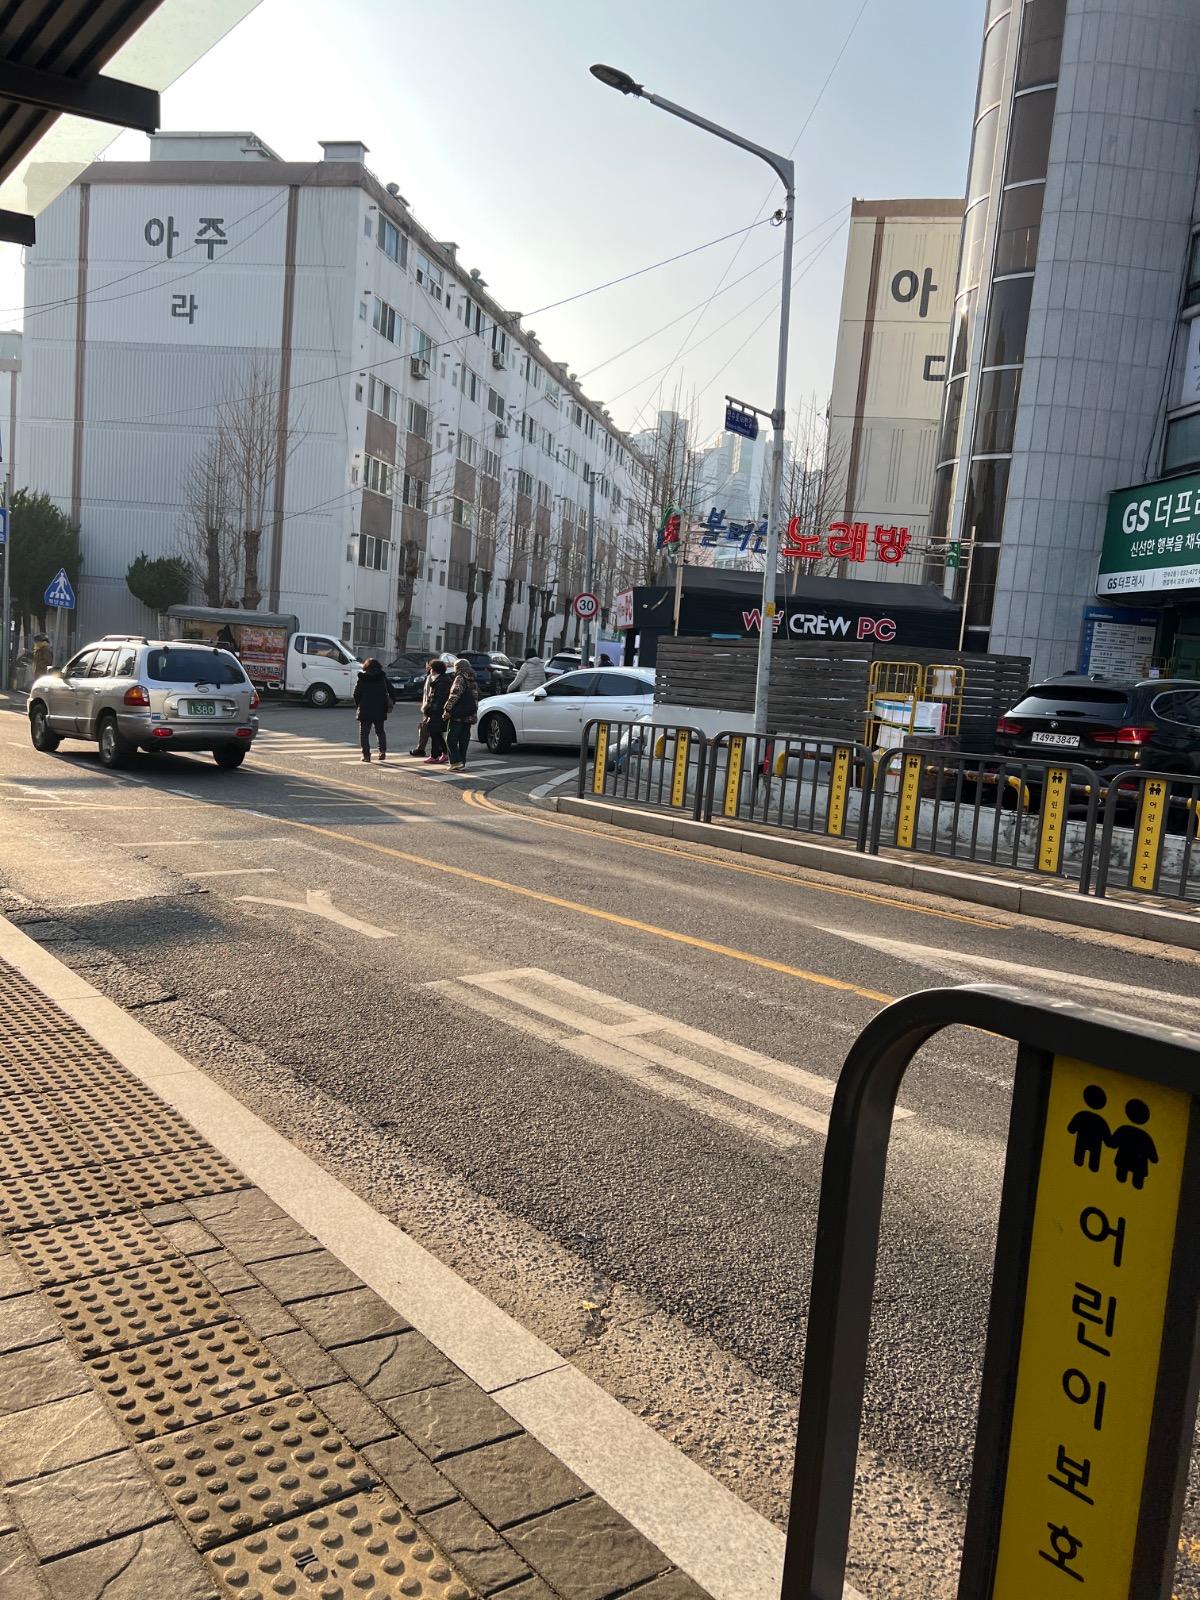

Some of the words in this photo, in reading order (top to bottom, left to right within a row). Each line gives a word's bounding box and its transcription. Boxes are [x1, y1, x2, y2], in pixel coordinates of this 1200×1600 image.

[145, 216, 228, 260] 아주
[171, 295, 199, 325] 라
[891, 267, 938, 318] 아
[1122, 500, 1152, 535] GS
[782, 516, 912, 564] 노래방
[1130, 538, 1155, 557] 신선한
[1157, 534, 1184, 554] 행복을
[1107, 578, 1118, 590] GS
[1118, 575, 1146, 589] 더프레시
[579, 599, 594, 611] 30
[789, 613, 851, 637] CREW
[856, 616, 897, 641] PC
[191, 705, 214, 715] 1380
[1055, 735, 1077, 745] 3847
[902, 773, 915, 843] 어린이보호구역
[1044, 789, 1060, 867] 어린이보호구역
[1139, 802, 1157, 884] 어린이보호구역
[1038, 1205, 1126, 1583] 어린이보호
